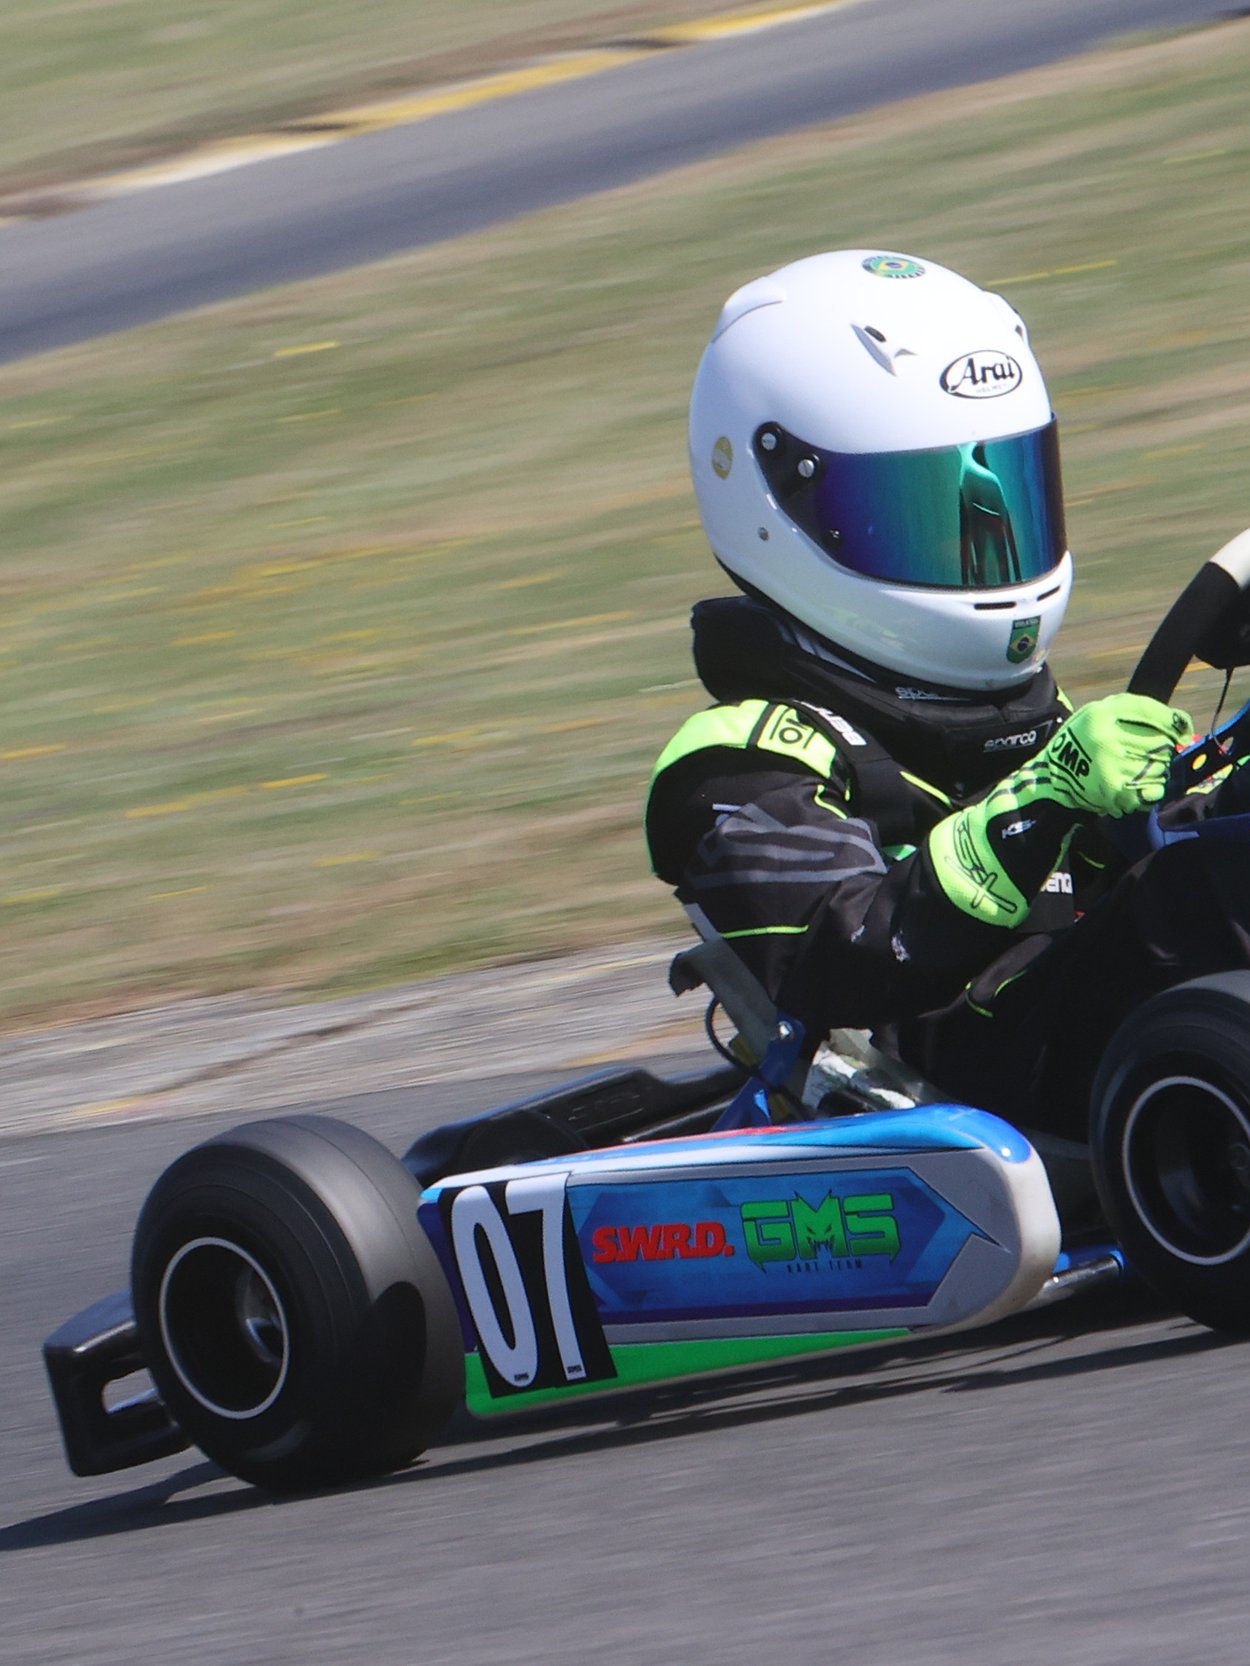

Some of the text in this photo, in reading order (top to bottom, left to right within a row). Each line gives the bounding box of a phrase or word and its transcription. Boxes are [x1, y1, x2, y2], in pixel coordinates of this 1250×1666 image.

[950, 355, 1014, 390] Arai
[1052, 732, 1090, 779] OMP
[740, 1191, 901, 1268] GMS
[451, 1171, 586, 1387] 07
